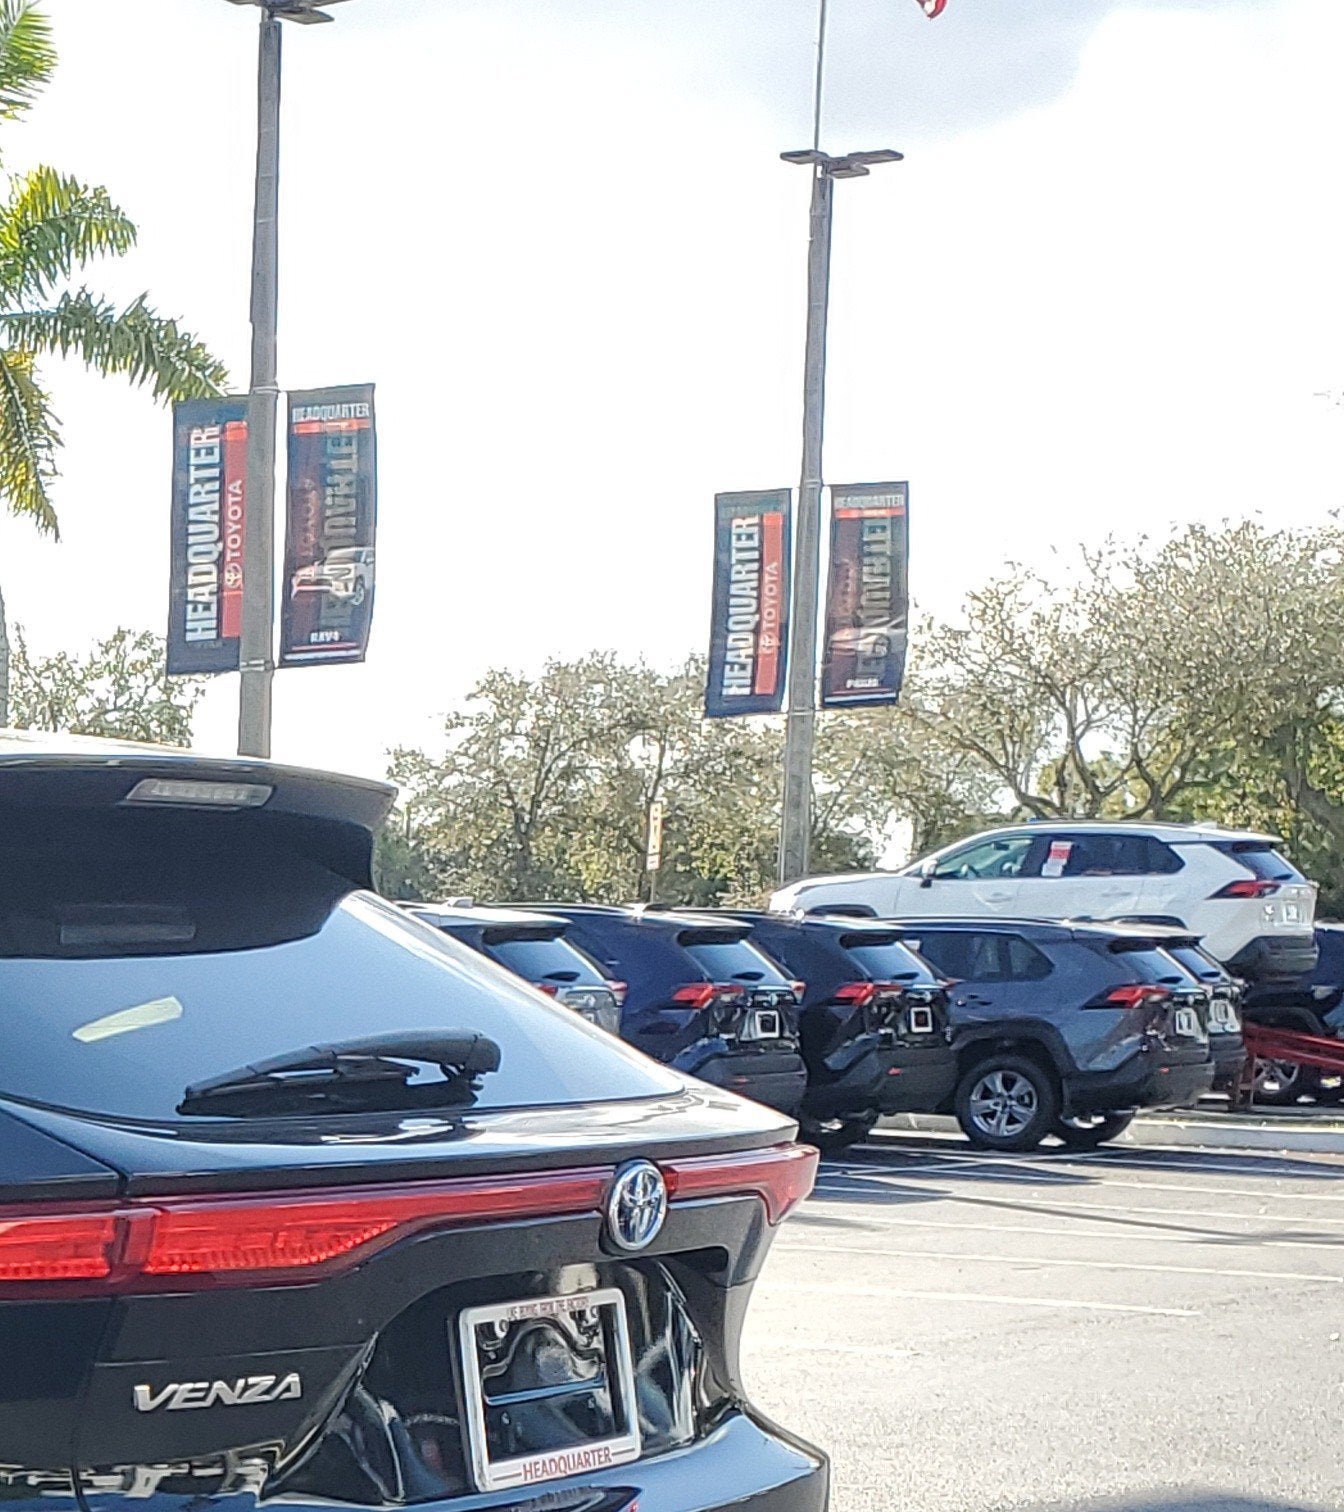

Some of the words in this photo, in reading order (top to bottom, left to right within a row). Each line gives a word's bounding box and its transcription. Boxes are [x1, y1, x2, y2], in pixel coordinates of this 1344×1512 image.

[185, 425, 223, 642] HEADQUARTER
[226, 479, 243, 561] TOYOTA
[721, 515, 759, 696] HEADQUARTER
[763, 562, 778, 633] TOYOTA
[134, 1372, 302, 1412] VENZA
[522, 1446, 612, 1481] HEADQUARTER
